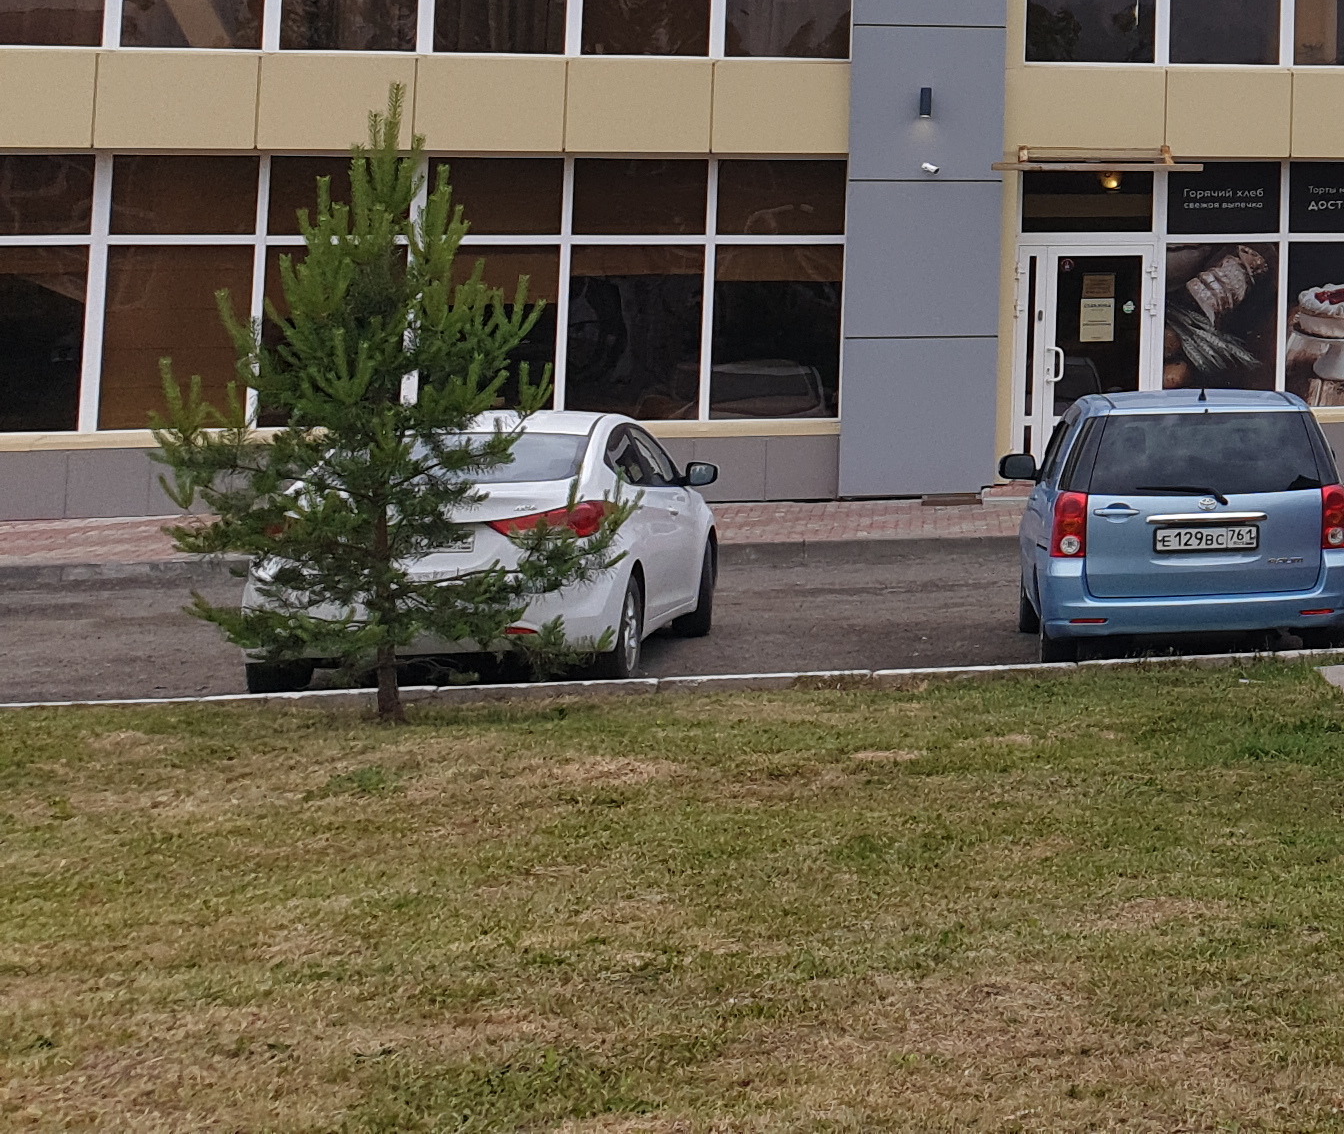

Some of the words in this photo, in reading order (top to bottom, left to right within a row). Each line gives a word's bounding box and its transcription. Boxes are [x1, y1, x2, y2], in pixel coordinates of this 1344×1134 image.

[1184, 188, 1233, 199] Горячий
[1236, 188, 1264, 197] хлеб
[1308, 186, 1337, 194] Торты
[1162, 531, 1225, 547] Е129ВС
[1229, 529, 1254, 541] 761
